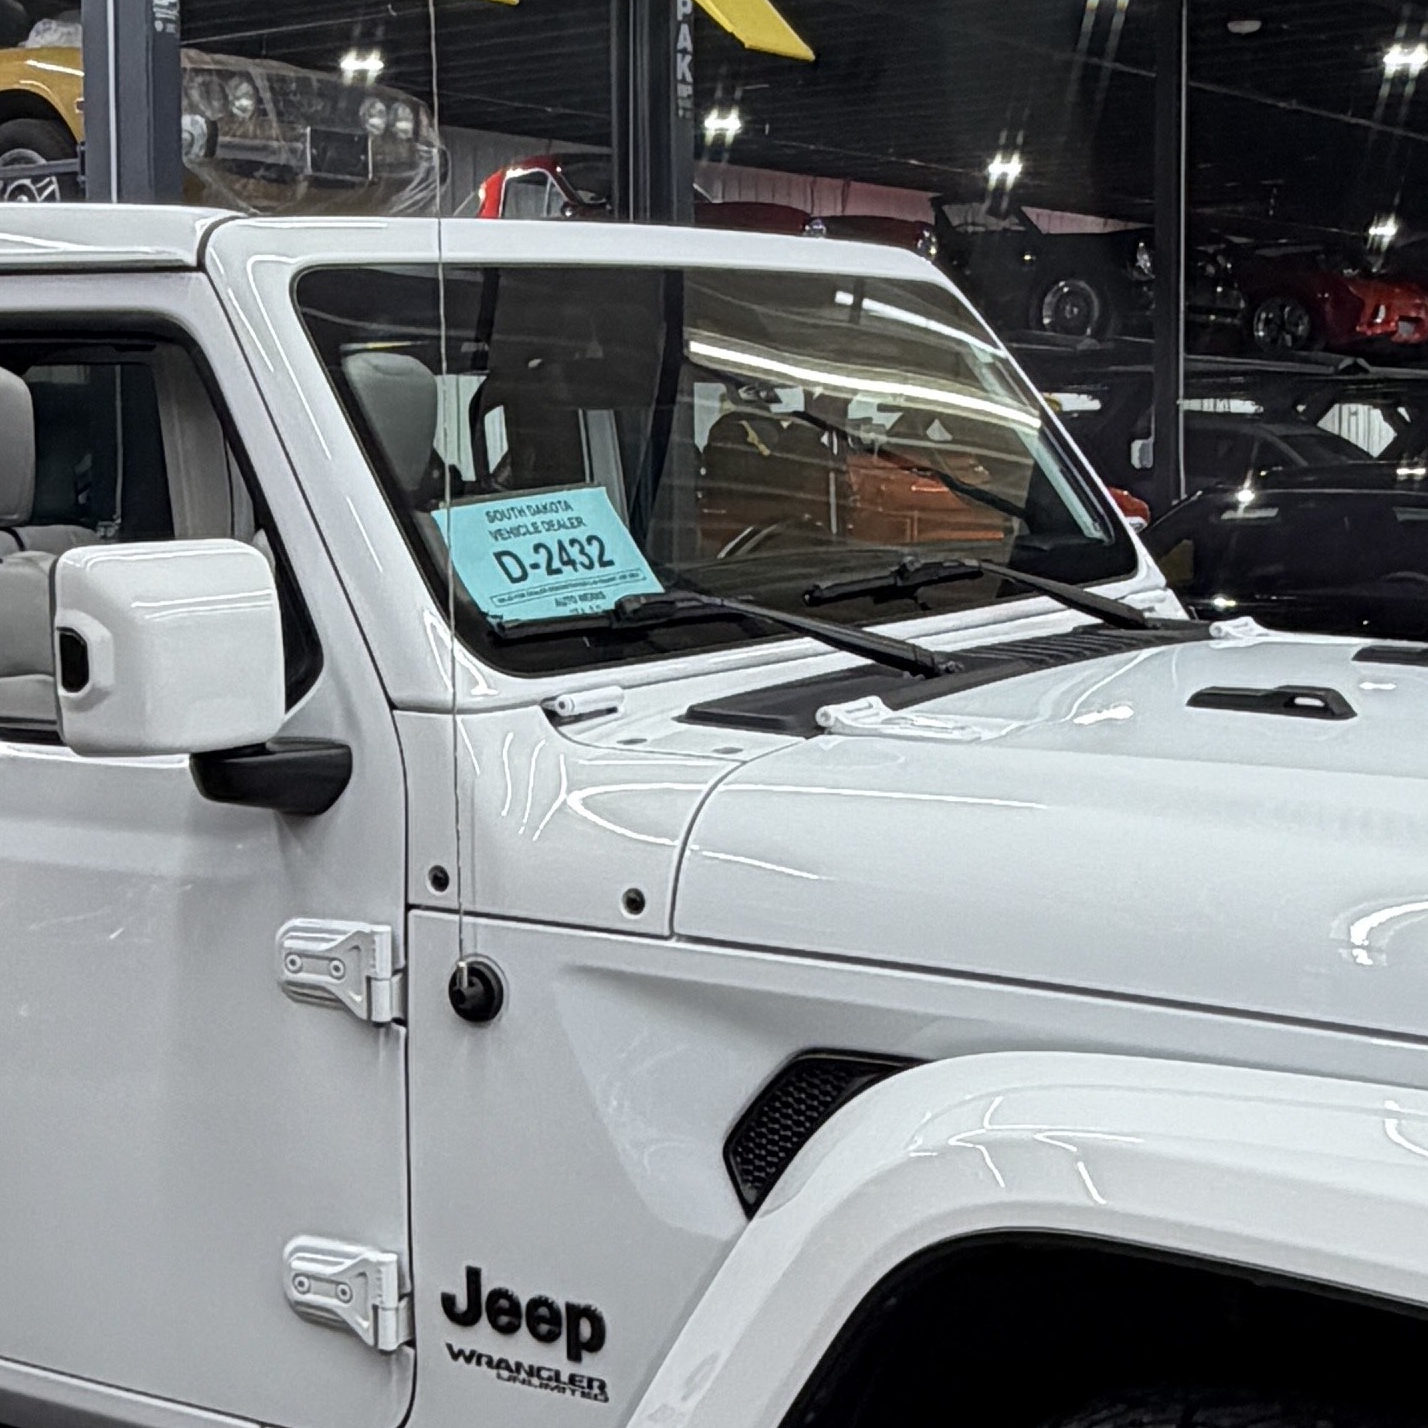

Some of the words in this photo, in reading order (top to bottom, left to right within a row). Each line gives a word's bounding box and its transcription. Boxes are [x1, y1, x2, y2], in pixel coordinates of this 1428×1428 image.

[485, 504, 527, 524] SOUTH
[527, 499, 575, 519] DAKOTA
[488, 522, 541, 542] VEHICLE
[541, 516, 588, 533] DEALER
[493, 534, 615, 584] D-2432
[441, 1265, 606, 1363] Jeep
[445, 1342, 607, 1392] WRANGLER
[496, 1370, 610, 1403] UNLIMITED
